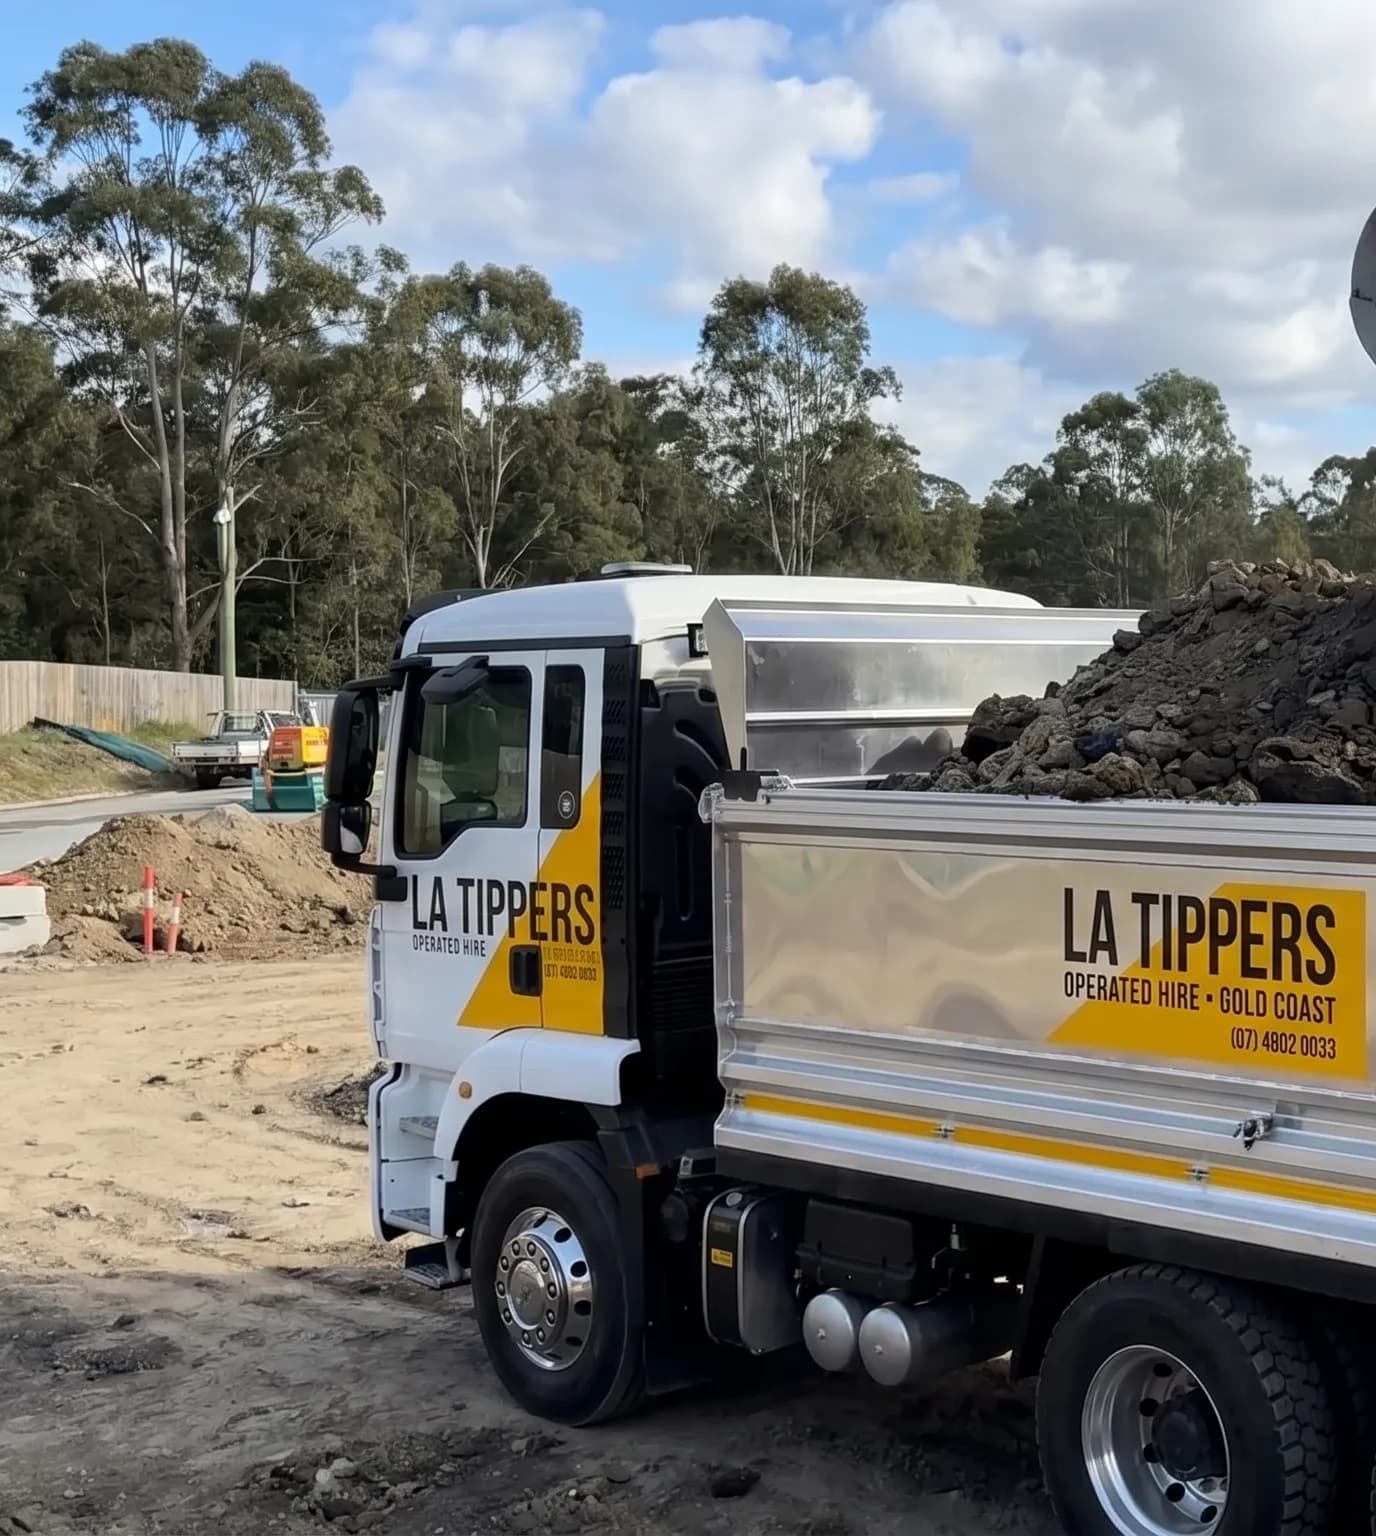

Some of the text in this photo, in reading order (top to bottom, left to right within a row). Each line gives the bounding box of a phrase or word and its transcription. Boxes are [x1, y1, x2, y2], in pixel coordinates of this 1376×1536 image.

[412, 874, 595, 945] LA TIPPERS
[413, 934, 486, 957] OPERATED HIRE
[1064, 888, 1336, 985] LA TIPPERS
[1064, 971, 1151, 1006] OPERATED
[1158, 980, 1200, 1011] HIRE
[1220, 986, 1267, 1017] GOLD
[1274, 991, 1336, 1024] COAST
[1231, 1026, 1336, 1060] (07) 4802 0033
